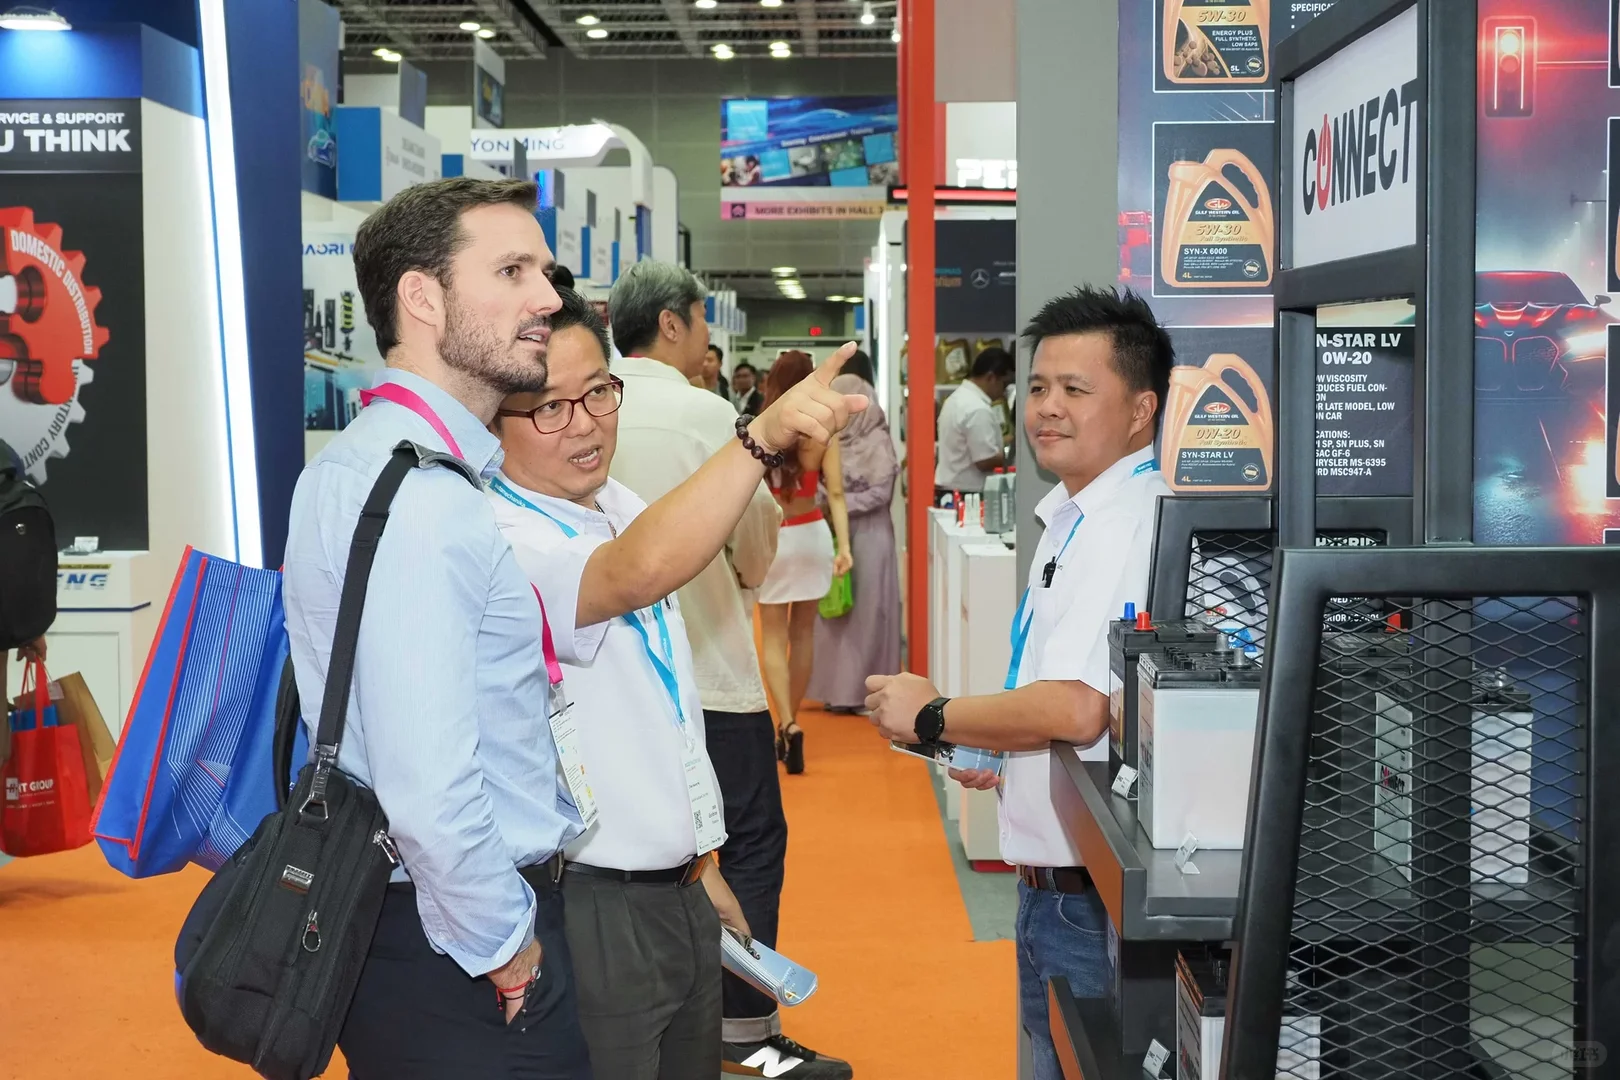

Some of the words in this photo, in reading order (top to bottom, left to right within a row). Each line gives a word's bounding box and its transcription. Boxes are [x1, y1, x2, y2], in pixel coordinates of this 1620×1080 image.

[1291, 3, 1334, 12] SPECIFICA
[1199, 10, 1246, 22] 5W-30
[42, 113, 53, 124] &
[55, 112, 125, 124] SUPPORT
[23, 129, 132, 152] THINK
[471, 138, 510, 152] YON
[1303, 77, 1417, 215] CONNECT
[835, 206, 846, 214] IN
[849, 206, 874, 214] HALL
[1195, 224, 1242, 236] 5W-30
[1183, 247, 1208, 255] SYN-X
[1209, 247, 1228, 255] 6000
[1182, 271, 1192, 279] 4L
[11, 229, 65, 278] DOMESTIC
[62, 269, 94, 355] DISTRIBUTION
[1381, 333, 1401, 347] LV
[1322, 351, 1372, 365] 0W-20
[1316, 374, 1325, 383] W
[1326, 374, 1368, 383] VISCOSITY
[1346, 383, 1366, 392] FUEL
[1367, 383, 1388, 392] CON-
[1324, 402, 1344, 411] LATE
[1344, 402, 1376, 411] MODEL,
[1377, 402, 1395, 411] LOW
[1325, 412, 1342, 420] CAR
[1196, 428, 1241, 440] 0W-20
[1322, 440, 1334, 449] SP,
[1336, 440, 1347, 448] SN
[1348, 440, 1372, 449] PLUS,
[1373, 440, 1385, 448] SN
[1181, 451, 1222, 459] SYN-STAR
[1223, 451, 1234, 459] LV
[1331, 449, 1351, 458] GF-6
[1349, 458, 1386, 467] MS-6395
[1330, 468, 1372, 476] MSC947-A
